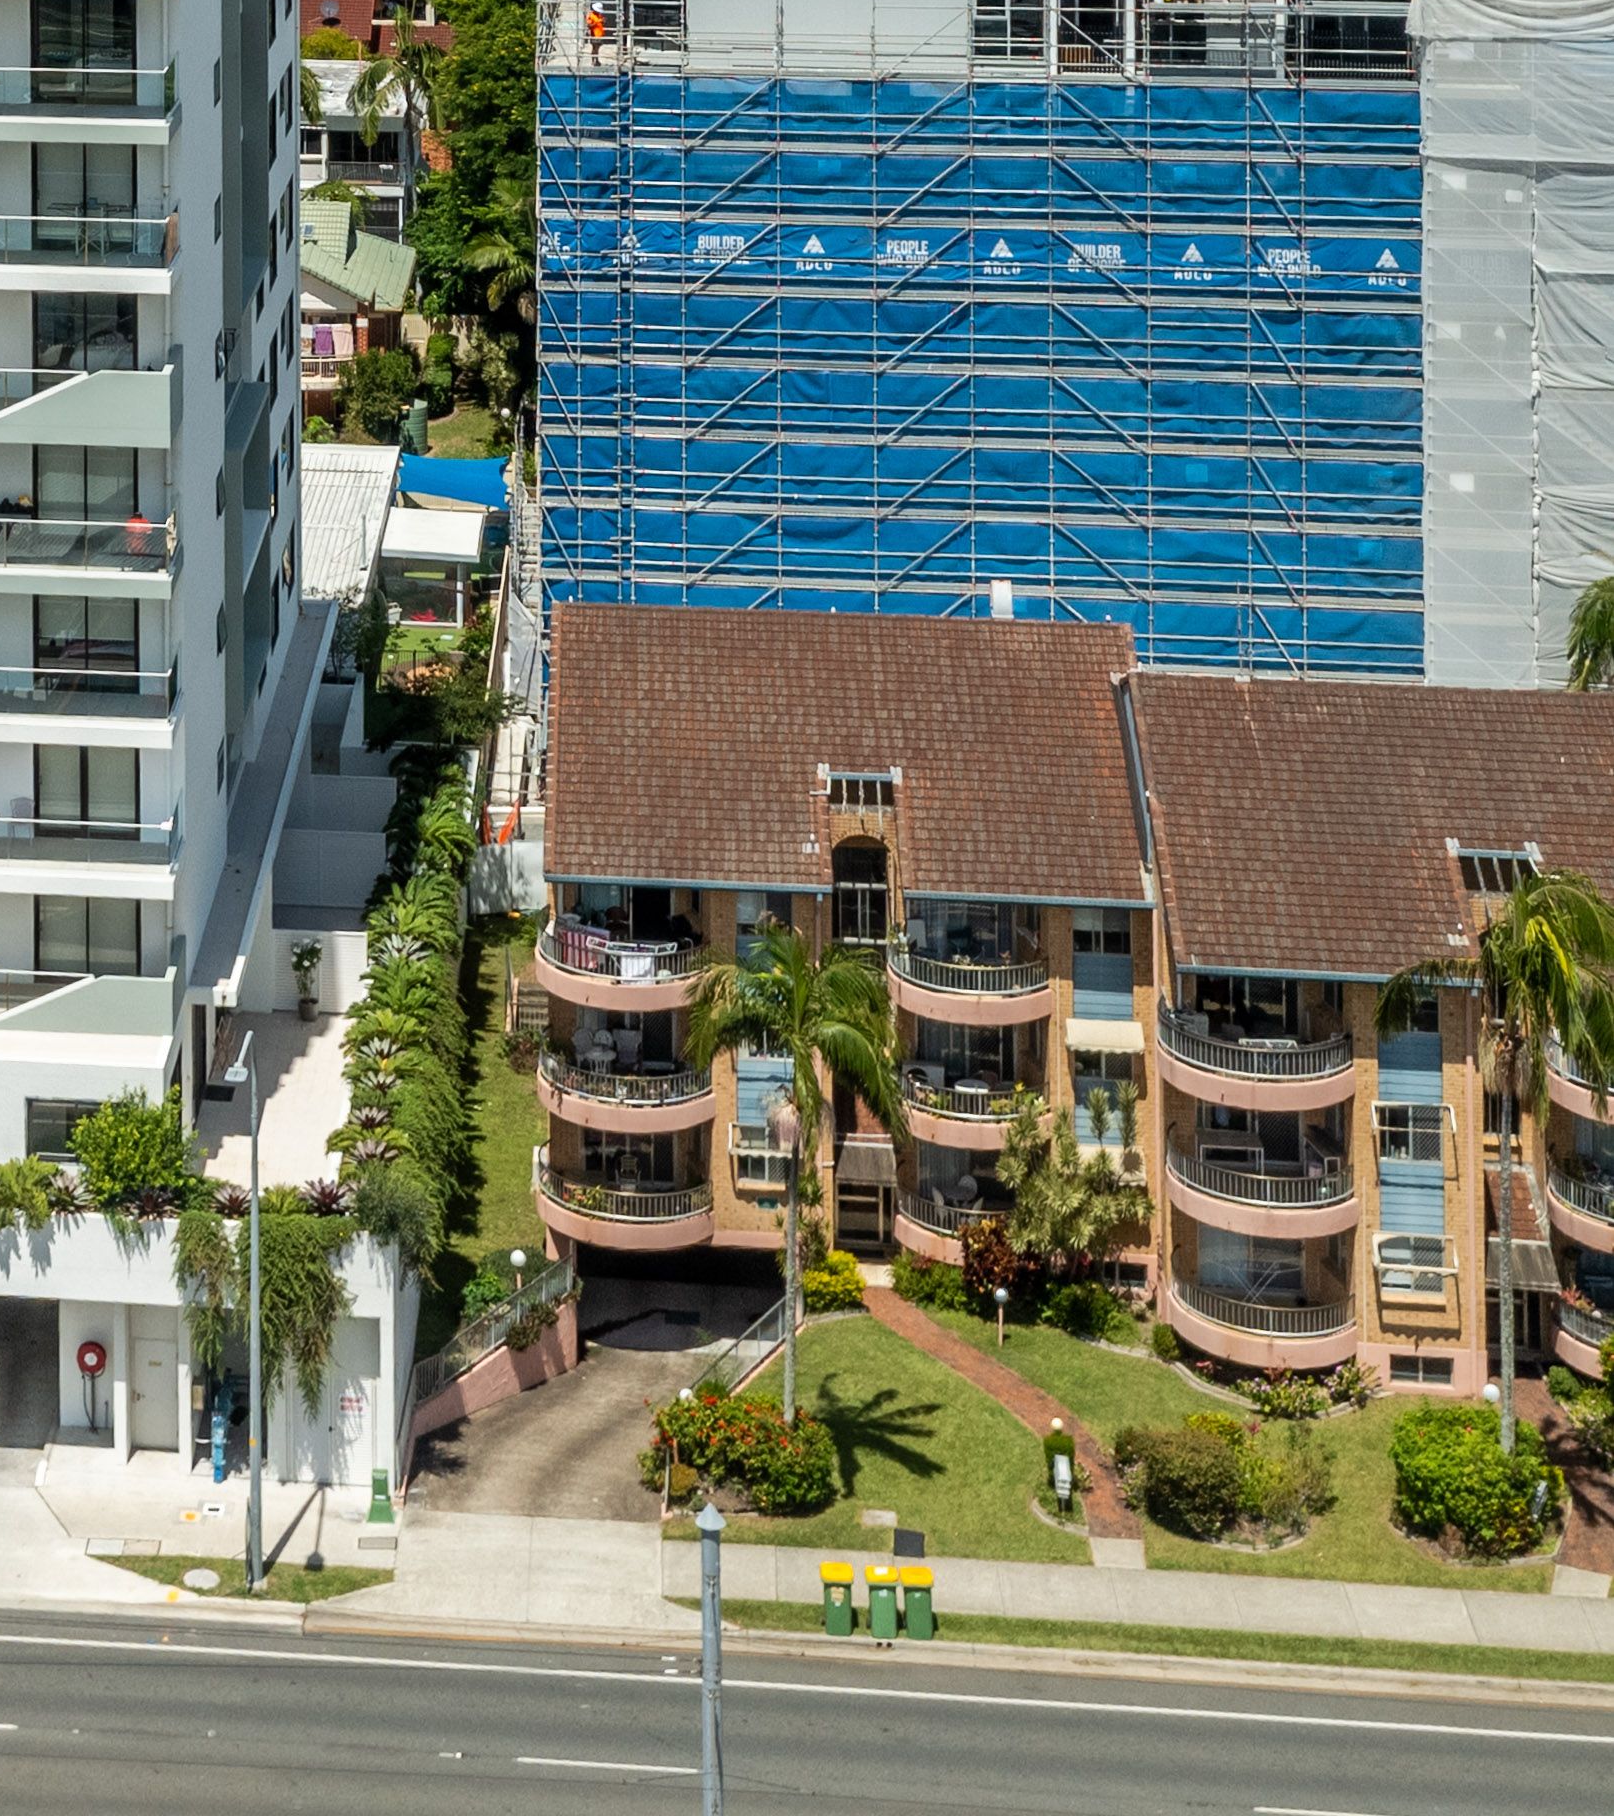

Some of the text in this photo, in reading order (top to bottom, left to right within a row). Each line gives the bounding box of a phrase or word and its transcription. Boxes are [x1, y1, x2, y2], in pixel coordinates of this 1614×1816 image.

[698, 235, 745, 250] BUILDER
[886, 240, 929, 255] PEOPLE
[1268, 249, 1311, 264] PEOPLE
